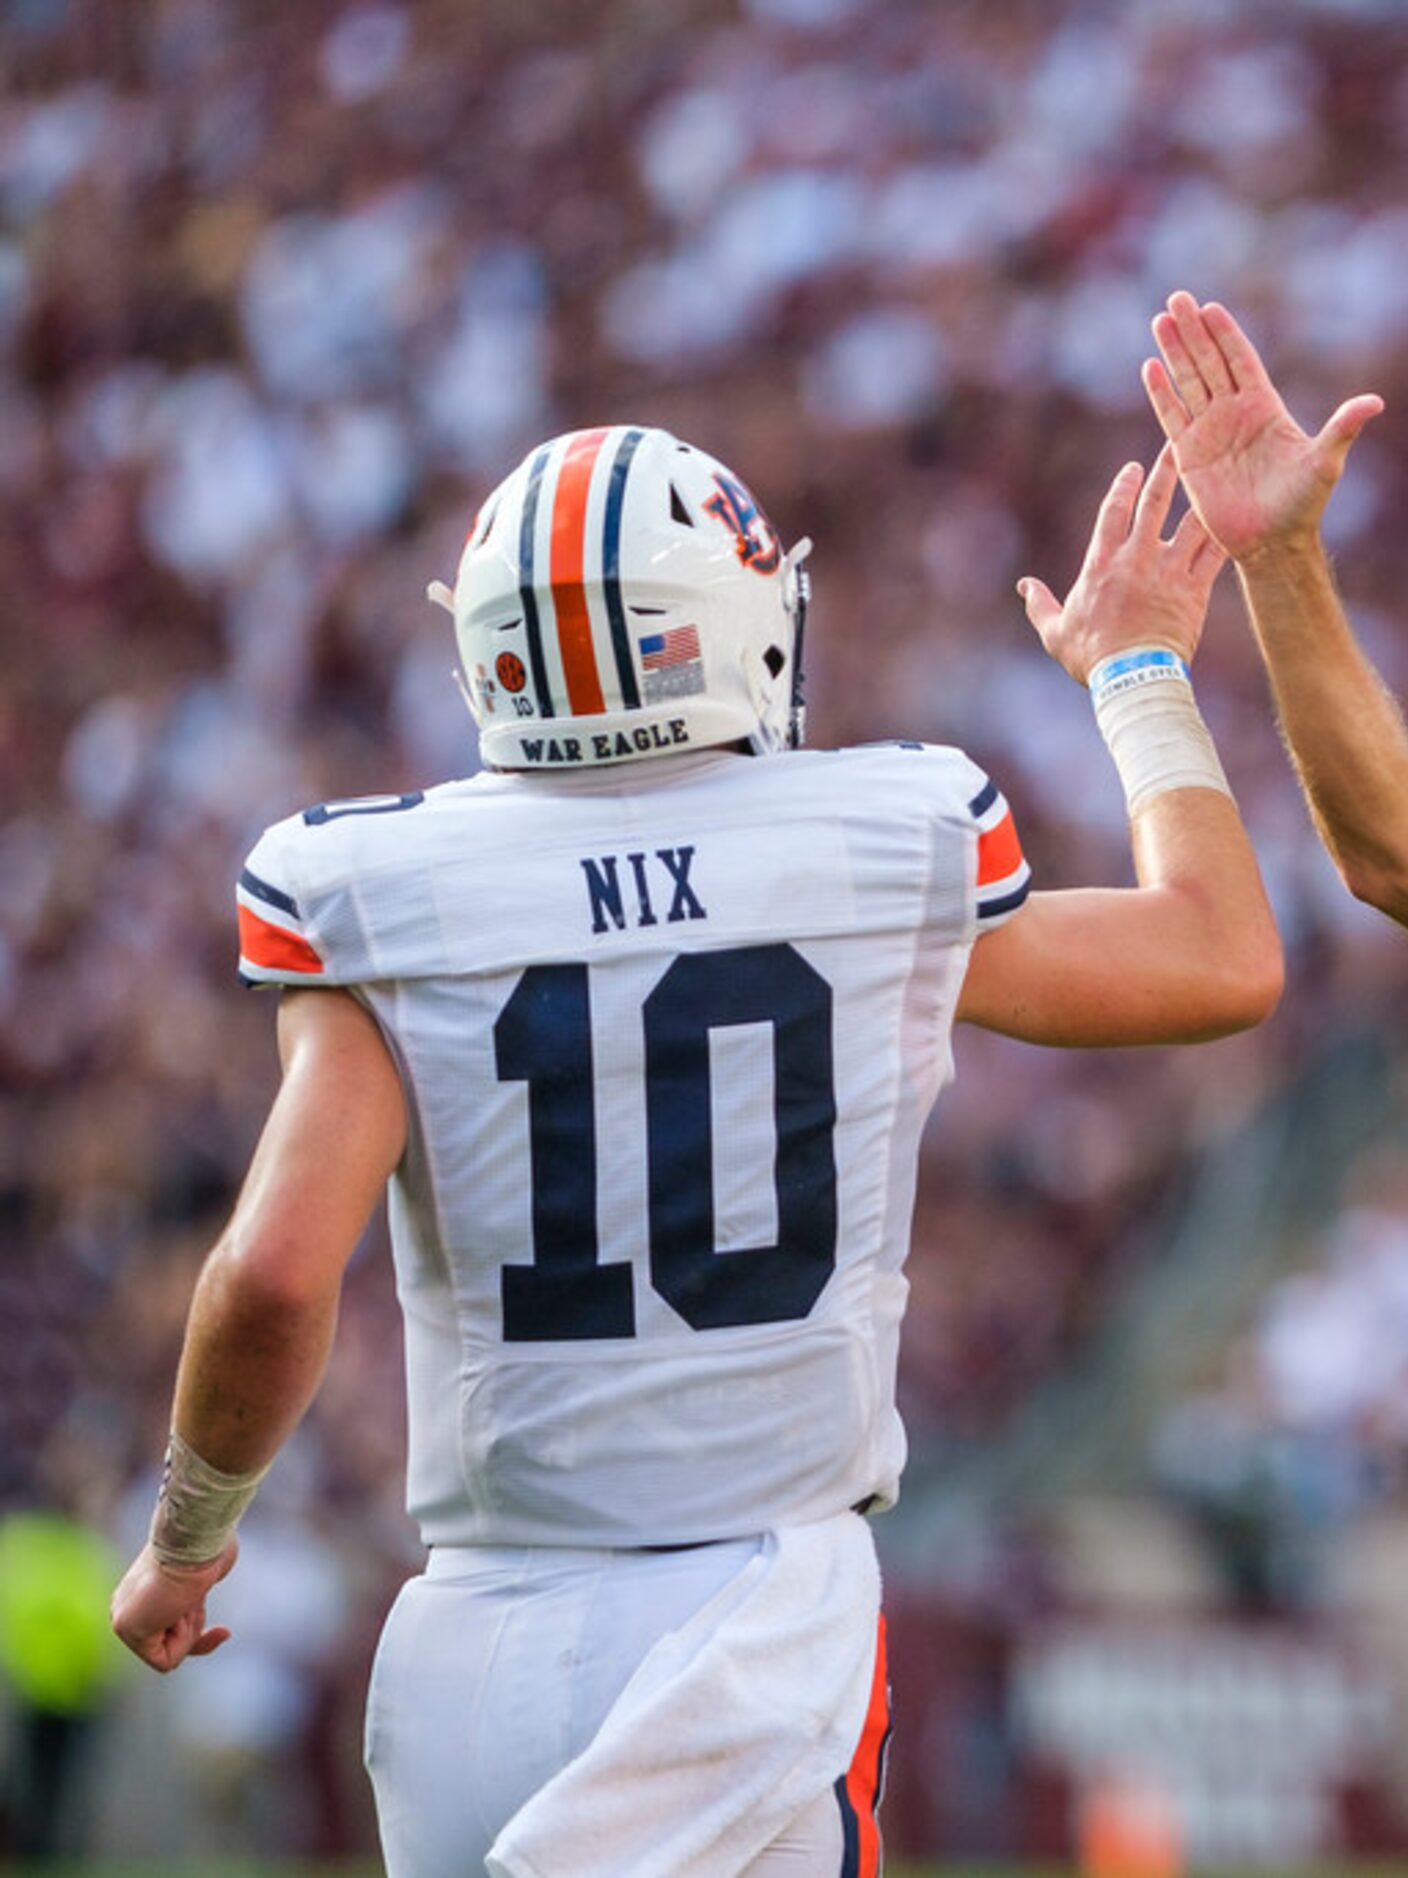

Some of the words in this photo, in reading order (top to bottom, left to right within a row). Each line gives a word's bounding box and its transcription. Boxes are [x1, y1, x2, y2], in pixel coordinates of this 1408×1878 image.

[511, 695, 534, 717] 10
[519, 738, 583, 763] WAR
[591, 718, 690, 759] EAGLE
[580, 845, 708, 935] NIX
[493, 942, 838, 1343] 10
